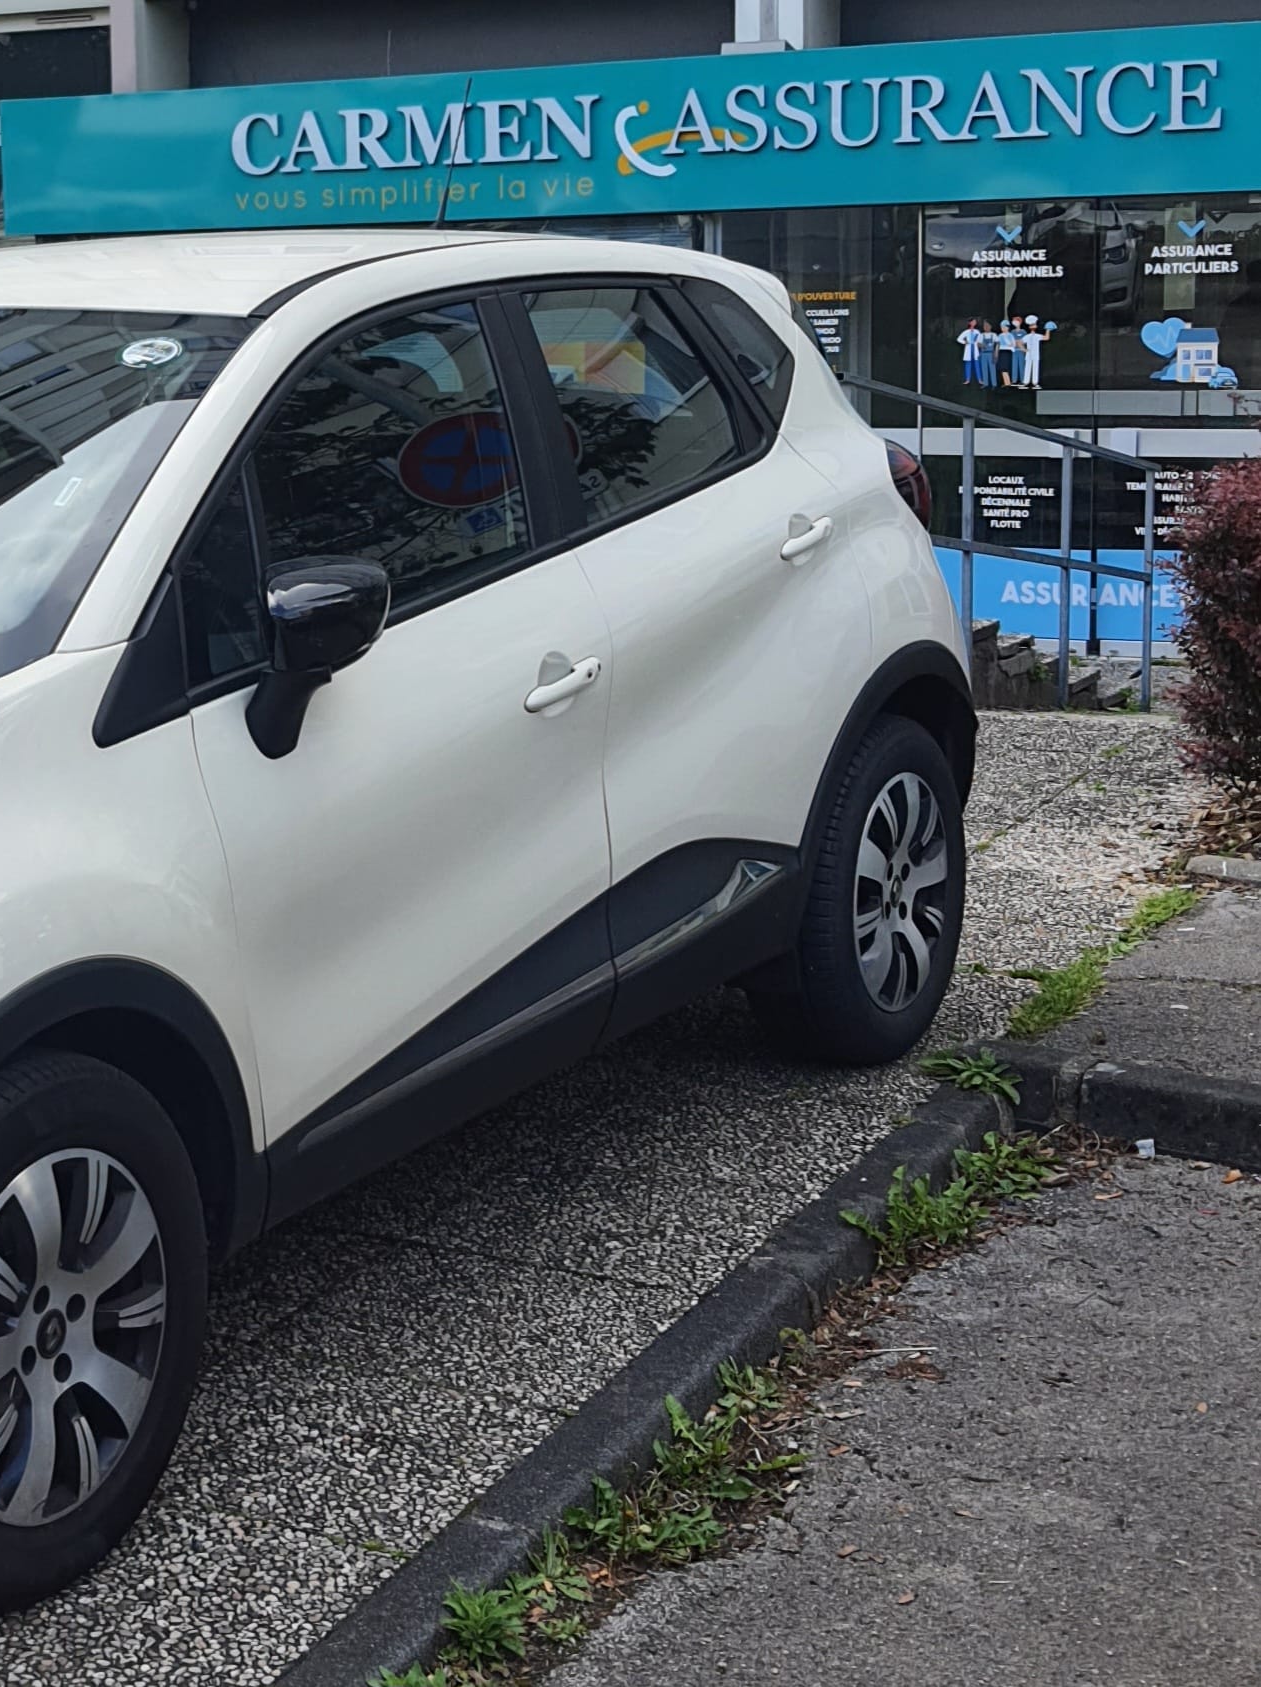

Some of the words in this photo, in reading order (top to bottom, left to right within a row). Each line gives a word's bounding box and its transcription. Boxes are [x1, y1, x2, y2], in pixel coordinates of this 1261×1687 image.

[231, 94, 600, 176] CARMEN
[661, 58, 1223, 155] ASSURANCE
[235, 190, 307, 211] vous
[322, 178, 481, 212] simplifier
[498, 174, 526, 199] la
[543, 173, 594, 197] vie
[971, 248, 1047, 263] ASSURANCE
[1150, 243, 1234, 259] ASSURANCE
[954, 264, 1064, 280] PROFESSIONNELS
[1144, 260, 1240, 276] PARTICULIERS
[988, 475, 1025, 485] LOCAUX
[1154, 470, 1179, 480] AUTO
[1027, 487, 1055, 497] CIVILE
[981, 496, 1032, 507] DÉCENNALE
[982, 507, 1010, 518] SANTÉ
[1010, 509, 1030, 518] PRO
[990, 519, 1022, 529] FLOTTE
